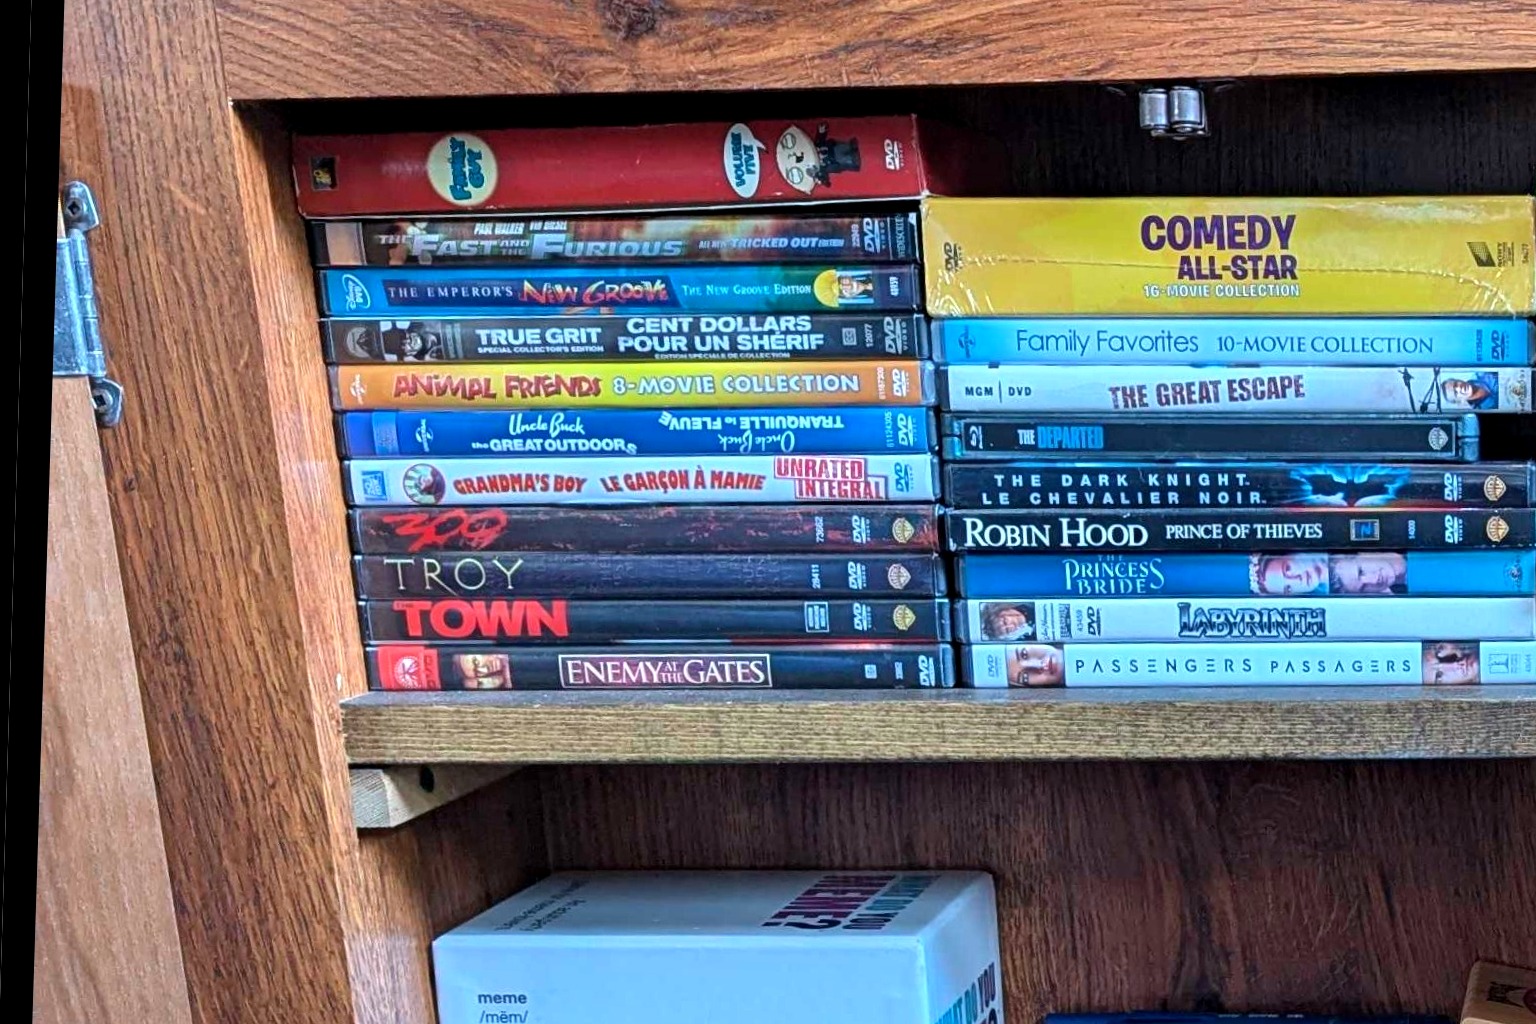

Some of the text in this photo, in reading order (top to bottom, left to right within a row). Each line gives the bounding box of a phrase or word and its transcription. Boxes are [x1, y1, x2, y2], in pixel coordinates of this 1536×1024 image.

[731, 132, 745, 188] VOLUME
[411, 232, 498, 257] FAST
[1140, 215, 1297, 251] COMEDY
[529, 233, 683, 260] FURIOUS
[1177, 255, 1299, 281] ALL-STAR
[388, 286, 513, 298] THE EMPEROR'S
[1215, 284, 1299, 297] COLLECTION
[475, 327, 602, 345] TRUE GRIT
[627, 315, 812, 334] CENT DOLLARS
[617, 331, 825, 352] POUR UN SHÉRIF
[1016, 329, 1434, 356] Family Favorites 10-MOVIE COLLECTION
[504, 374, 861, 398] FRIENDS 8-MOVIE COLLECTION
[965, 386, 1032, 397] MGM DVD
[1109, 374, 1305, 409] THE GREAT ESCAPE
[508, 411, 586, 438] Uncle Buck
[740, 414, 845, 431] TRANQUILLE
[1037, 426, 1104, 449] DEPARTED
[775, 457, 864, 480] UNRATED
[994, 473, 1247, 488] THE DARK KNIGHT
[453, 473, 588, 495] GRANDMA'S BOY
[600, 470, 767, 494] LE GARÇON MAMIE
[797, 479, 884, 500] INTEGRAL
[981, 491, 1261, 505] LE CHEVALIER NOIR
[382, 507, 508, 552] 300
[963, 517, 1323, 547] ROBIN HOOD PRINCE OF THIEVES
[384, 557, 524, 596] TROY
[1062, 557, 1165, 590] PRINCESS
[1077, 579, 1147, 595] BRIDE
[392, 600, 569, 637] TOWN
[1177, 602, 1326, 637] LABYRINTH
[567, 659, 765, 684] ENEMY AT GATES
[1076, 659, 1412, 673] PASSENGERS PASSAGERS
[478, 993, 528, 1004] meme
